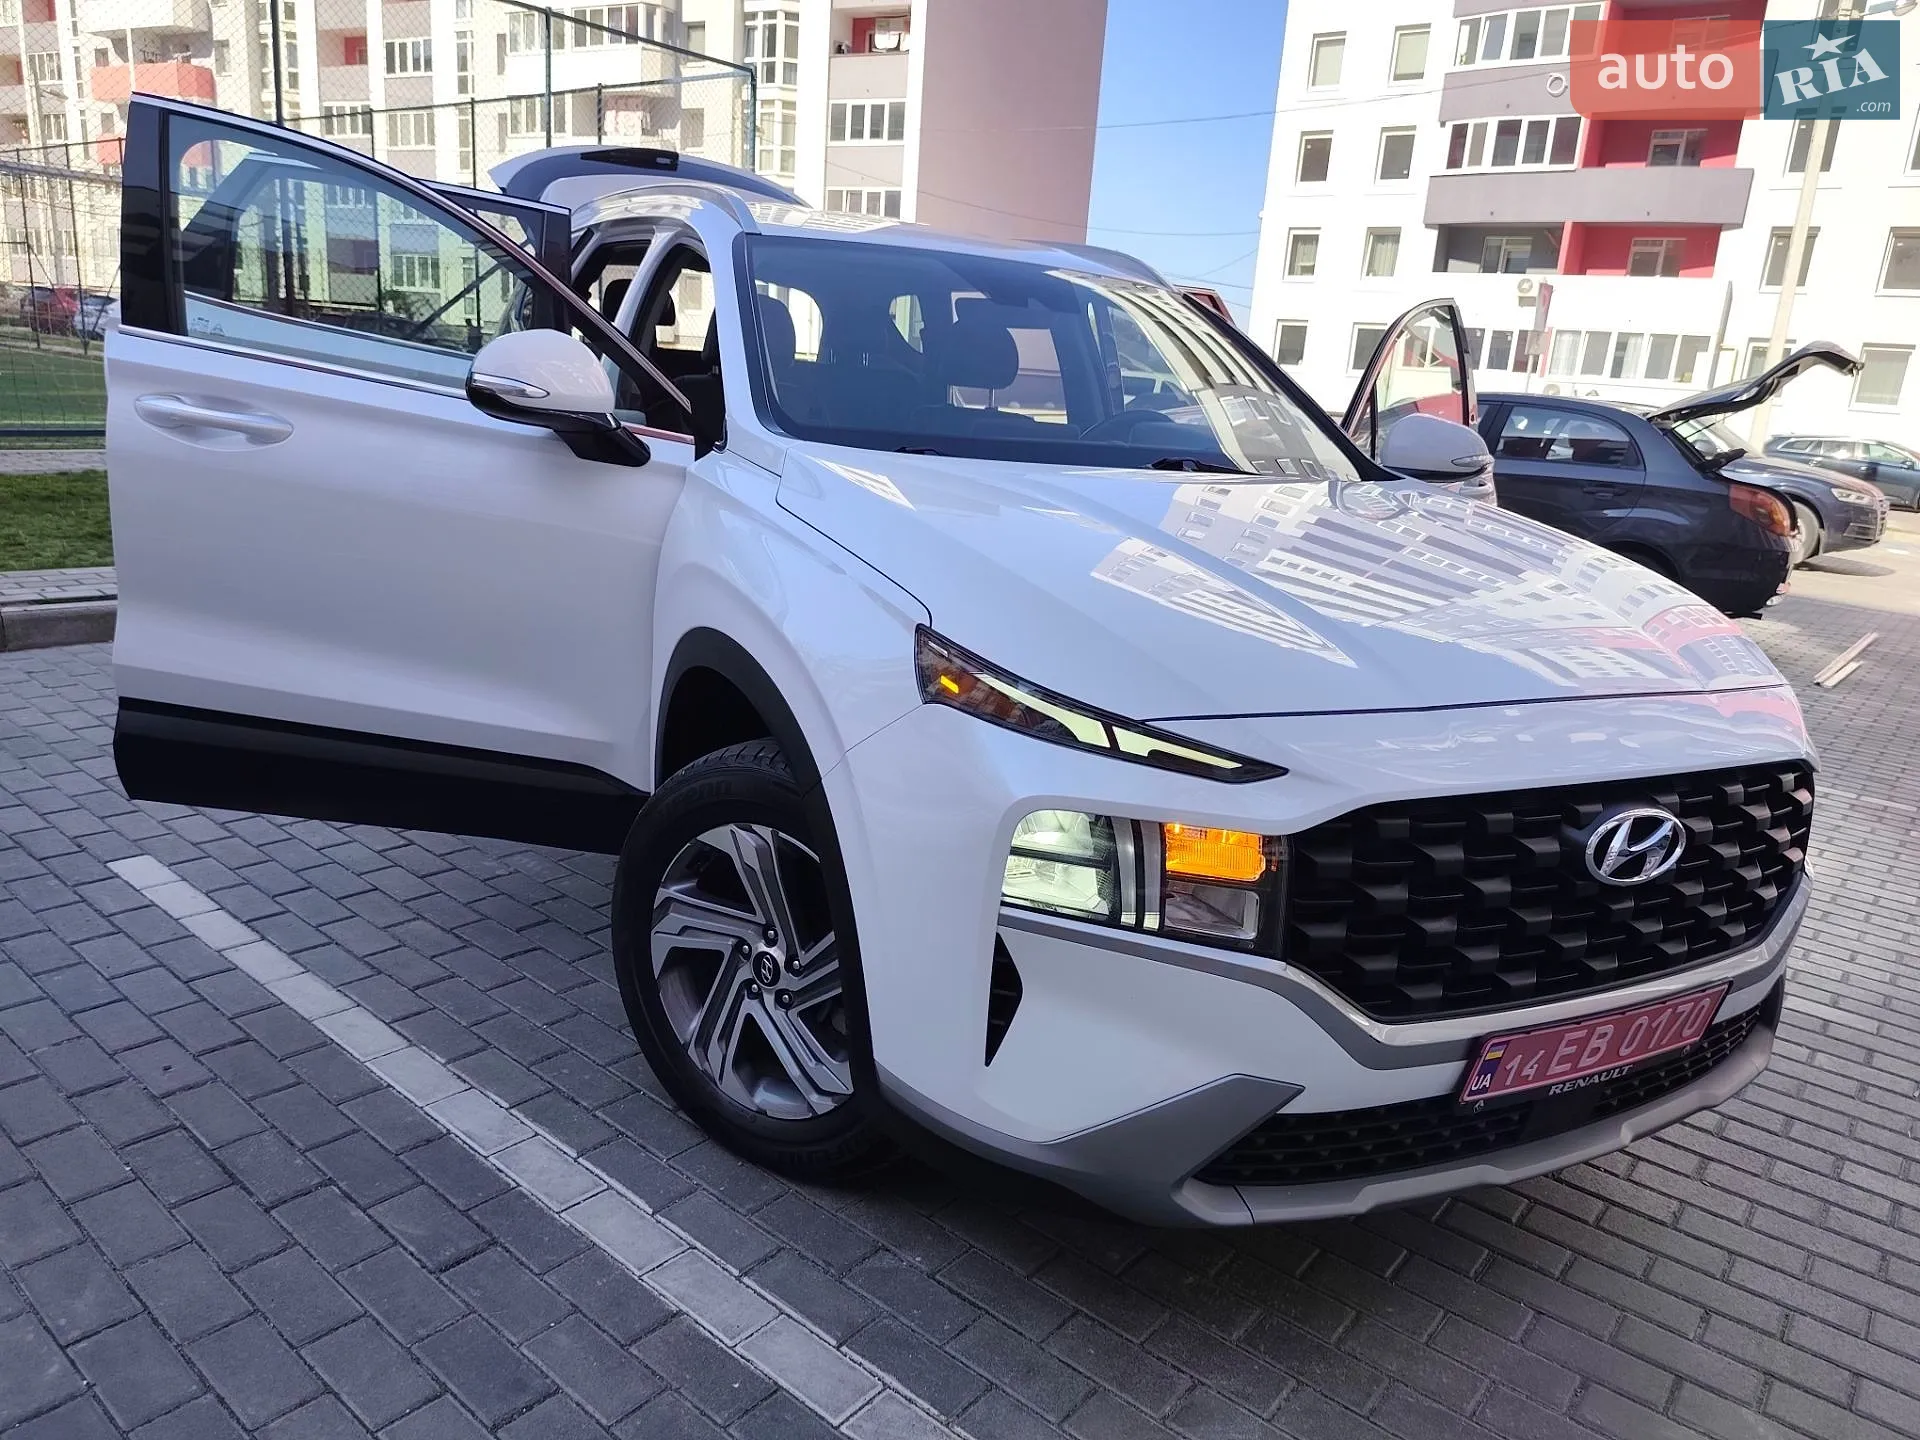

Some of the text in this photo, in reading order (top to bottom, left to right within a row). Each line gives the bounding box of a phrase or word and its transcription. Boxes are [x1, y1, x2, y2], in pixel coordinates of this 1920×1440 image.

[1505, 998, 1712, 1086] 14 EB 0170
[1471, 1073, 1492, 1091] UA
[1548, 1064, 1634, 1096] RENAULT
